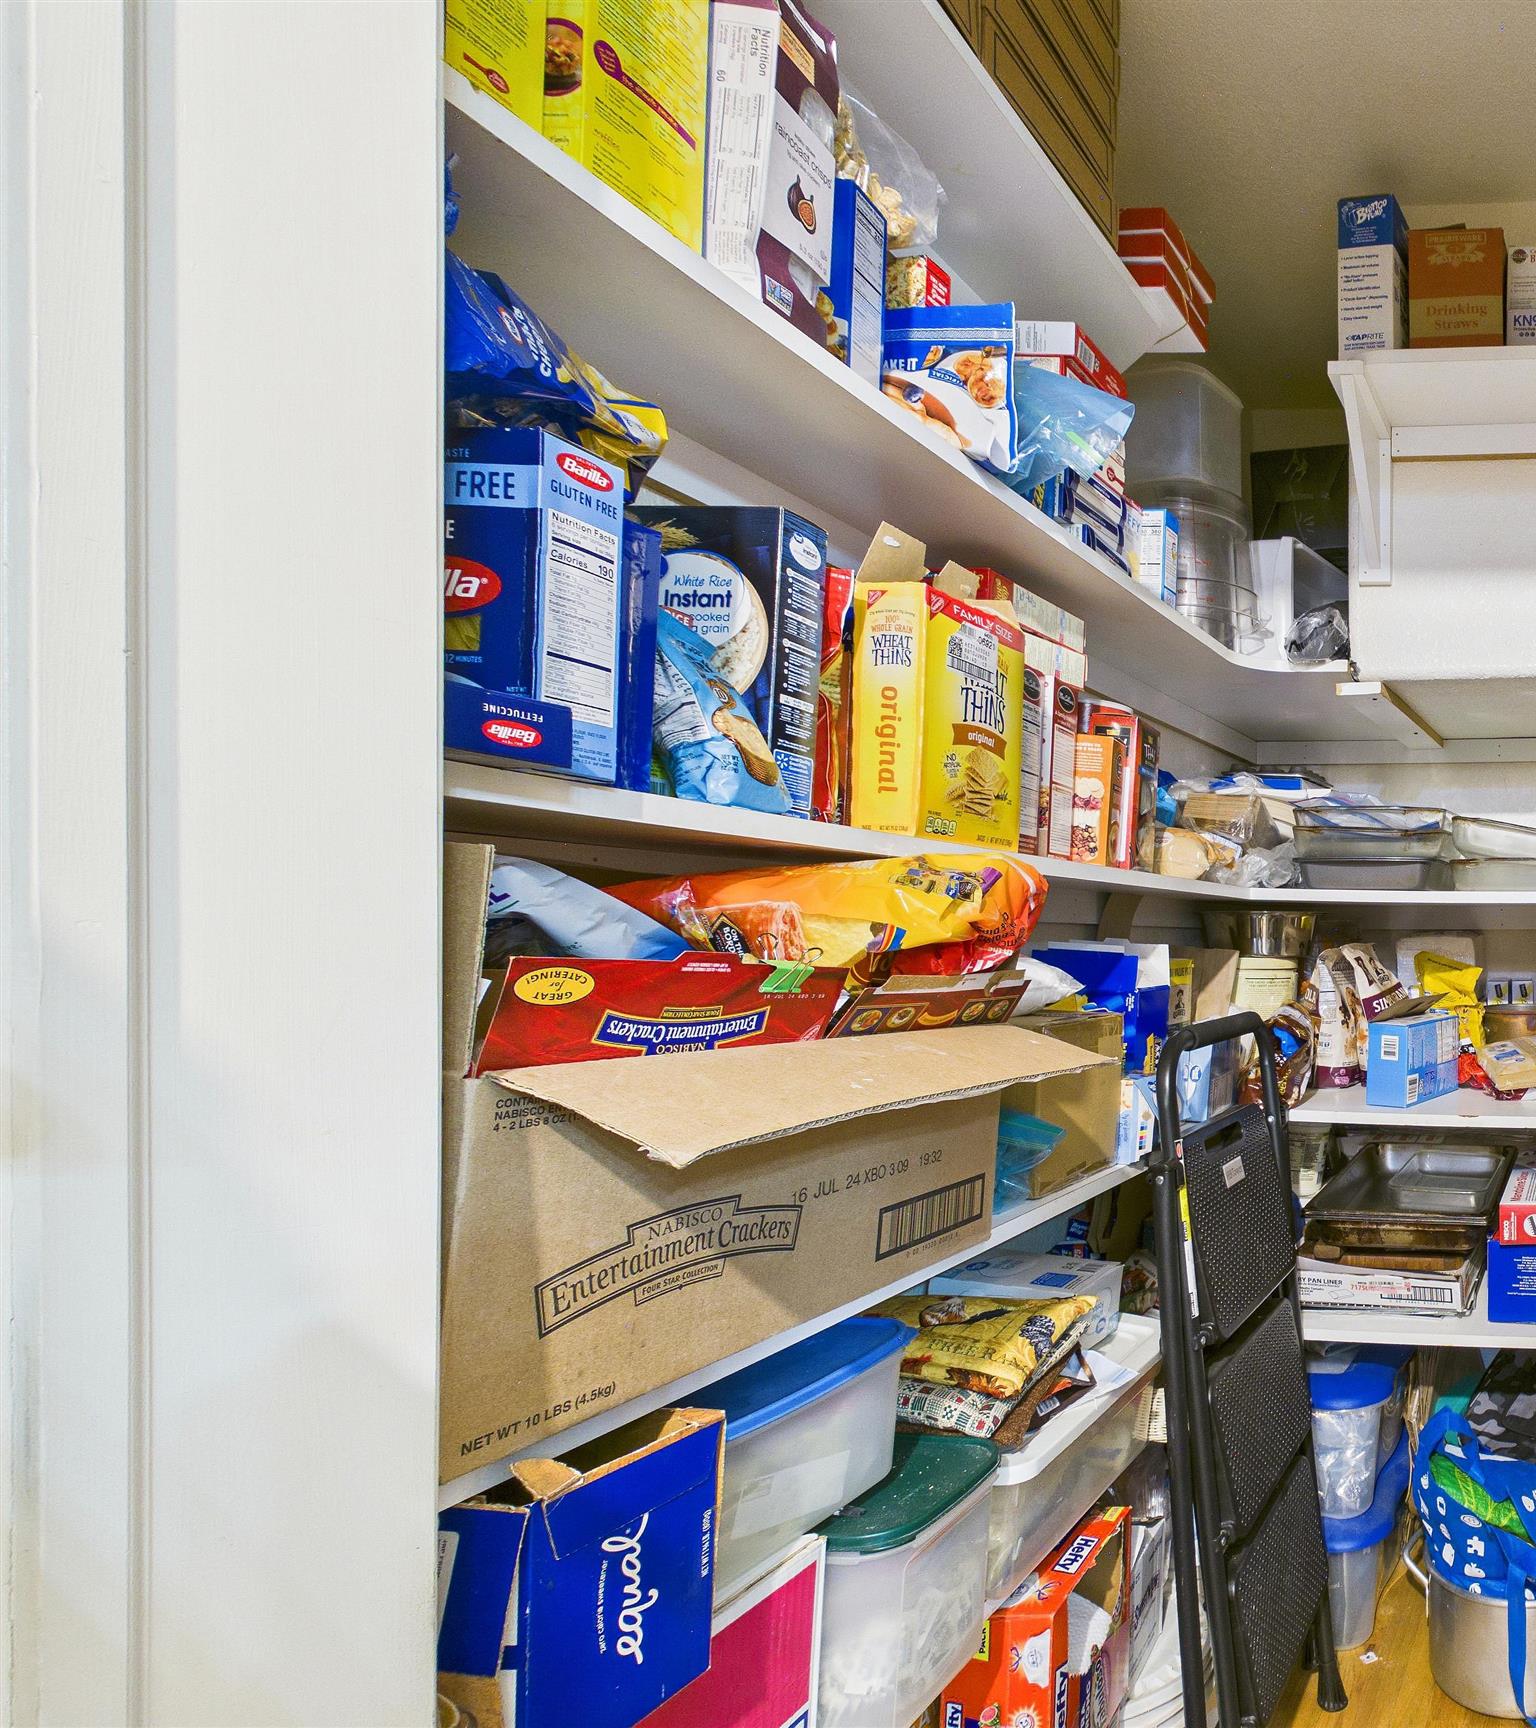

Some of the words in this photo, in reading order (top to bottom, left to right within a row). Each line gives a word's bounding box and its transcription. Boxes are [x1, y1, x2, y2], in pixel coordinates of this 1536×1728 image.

[749, 27, 760, 57] Facts
[759, 29, 772, 77] Nutrition
[716, 69, 726, 82] 60
[1427, 303, 1488, 316] Drinking
[1434, 317, 1479, 329] Straws
[907, 357, 919, 371] IT
[562, 457, 611, 489] Barilla
[455, 470, 516, 500] FREE
[550, 479, 592, 509] GLUTEN
[596, 499, 618, 521] FREE
[552, 511, 593, 535] Nutrition
[594, 528, 616, 545] Facts
[550, 549, 588, 569] Calories
[598, 565, 614, 579] 190
[674, 574, 705, 587] White
[708, 574, 733, 587] Rice
[664, 589, 733, 608] Instant
[701, 624, 730, 635] grain
[871, 622, 893, 633] WHOLE
[894, 623, 913, 633] GRAIN
[952, 605, 994, 631] FAMILY
[994, 625, 1014, 643] SIZE
[870, 634, 913, 650] WHEAT
[455, 654, 483, 664] MINUTES
[482, 702, 544, 723] FETTUCCINE
[487, 724, 536, 744] Barilla
[875, 686, 902, 794] original
[967, 731, 995, 747] original
[946, 753, 957, 762] NO
[731, 928, 738, 938] ON
[526, 970, 588, 985] CATERING!
[550, 981, 566, 991] for
[532, 991, 573, 1001] GREAT
[606, 1019, 665, 1043] Crackers
[665, 1014, 760, 1043] Entertainment
[655, 1041, 706, 1055] NABISCO
[493, 1122, 500, 1132] 4
[509, 1121, 516, 1130] 2
[518, 1117, 541, 1129] LBS
[542, 1116, 550, 1125] 8
[552, 1113, 567, 1124] OZ
[494, 1105, 546, 1121] NABISCO
[791, 1187, 807, 1206] 16
[813, 1180, 839, 1199] JUL
[846, 1172, 861, 1190] 24
[863, 1165, 886, 1185] XBO
[896, 1159, 909, 1174] 09
[919, 1150, 943, 1168] 19:32
[648, 1206, 723, 1241] NABISCO
[549, 1225, 717, 1320] Entertainment
[717, 1213, 793, 1249] Crackers
[641, 1282, 662, 1296] FOUR
[662, 1275, 682, 1289] STAR
[681, 1263, 720, 1284] COLLECTION
[1307, 1277, 1322, 1285] PAN
[1322, 1278, 1343, 1286] LINER
[928, 1338, 980, 1360] FREE
[460, 1431, 495, 1457] NET
[497, 1423, 521, 1442] WT
[525, 1413, 541, 1430] 10
[544, 1402, 572, 1423] LBS
[575, 1382, 617, 1412] (4.5kg)
[1057, 1537, 1096, 1571] Hefty
[597, 1560, 609, 1606] sweetener
[601, 1511, 660, 1665] equal
[596, 1605, 605, 1634] calorie
[598, 1635, 607, 1654] zero
